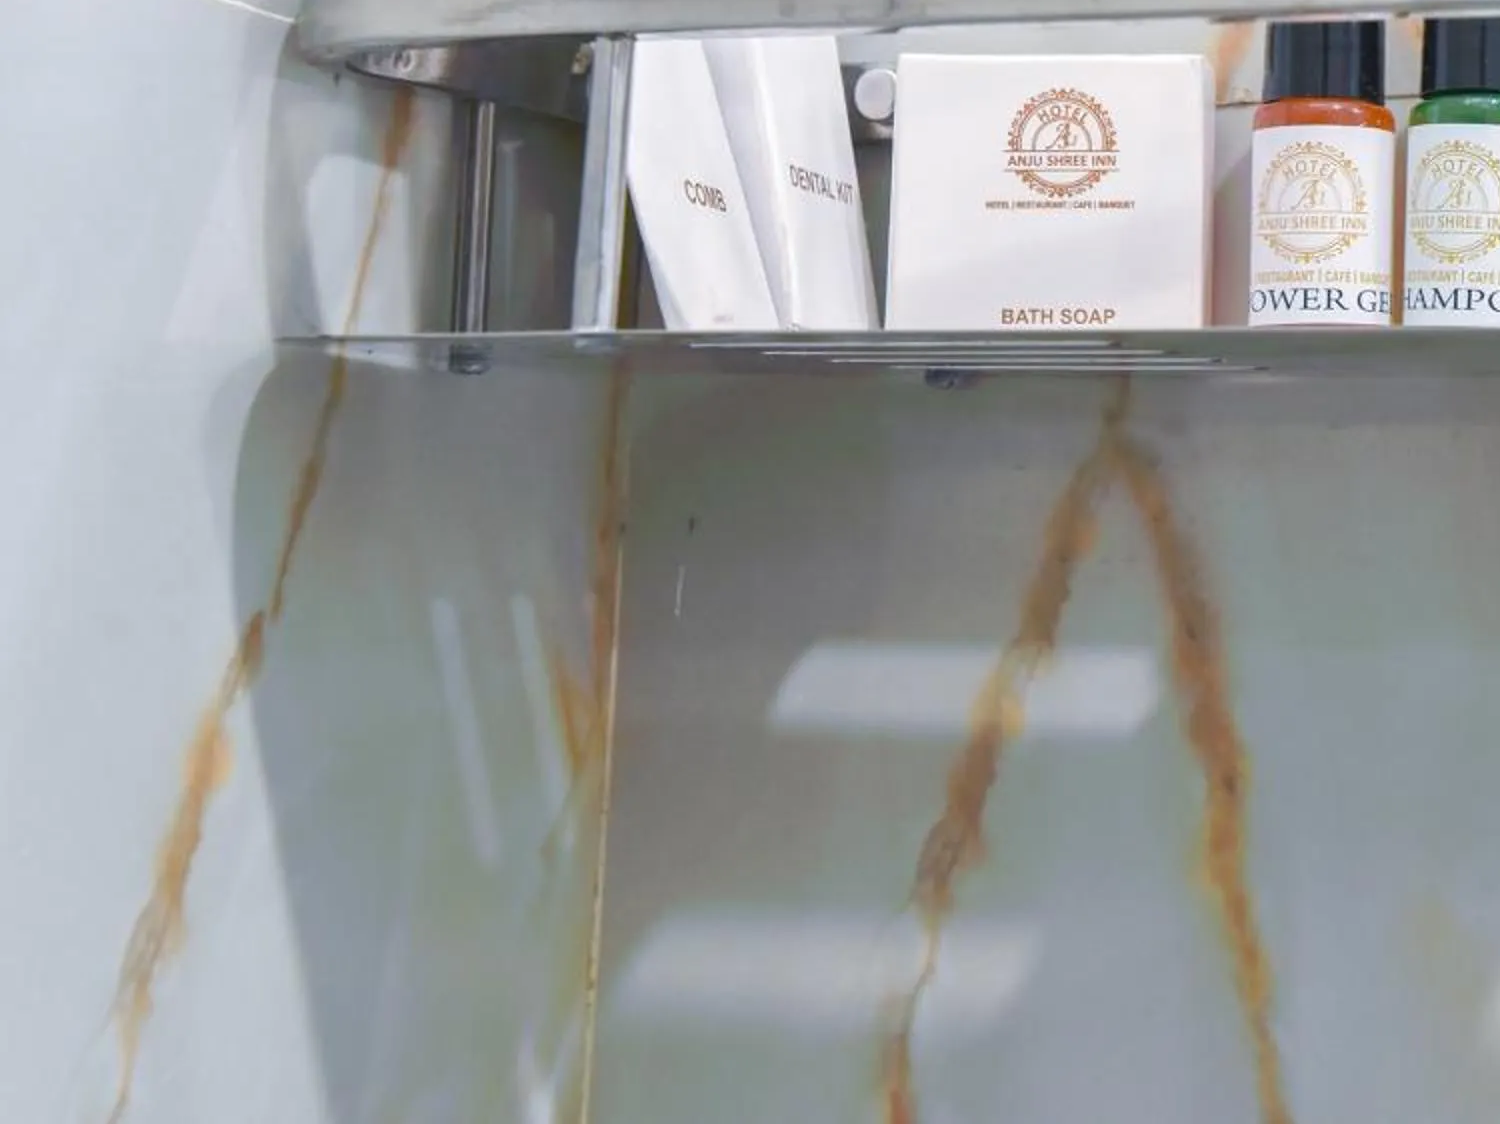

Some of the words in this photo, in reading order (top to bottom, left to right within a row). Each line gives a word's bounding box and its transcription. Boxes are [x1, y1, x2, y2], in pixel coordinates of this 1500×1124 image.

[1037, 103, 1090, 126] HOTEL
[1007, 155, 1043, 167] ANJU
[1046, 155, 1088, 167] SHREE
[1092, 155, 1117, 167] INN
[1282, 159, 1339, 180] HOTEL
[789, 164, 836, 201] DENTAL
[683, 179, 727, 213] COMB
[1291, 215, 1338, 229] SHREE
[1341, 216, 1367, 230] INN
[1001, 308, 1054, 325] BATH
[1060, 308, 1116, 325] SOAP
